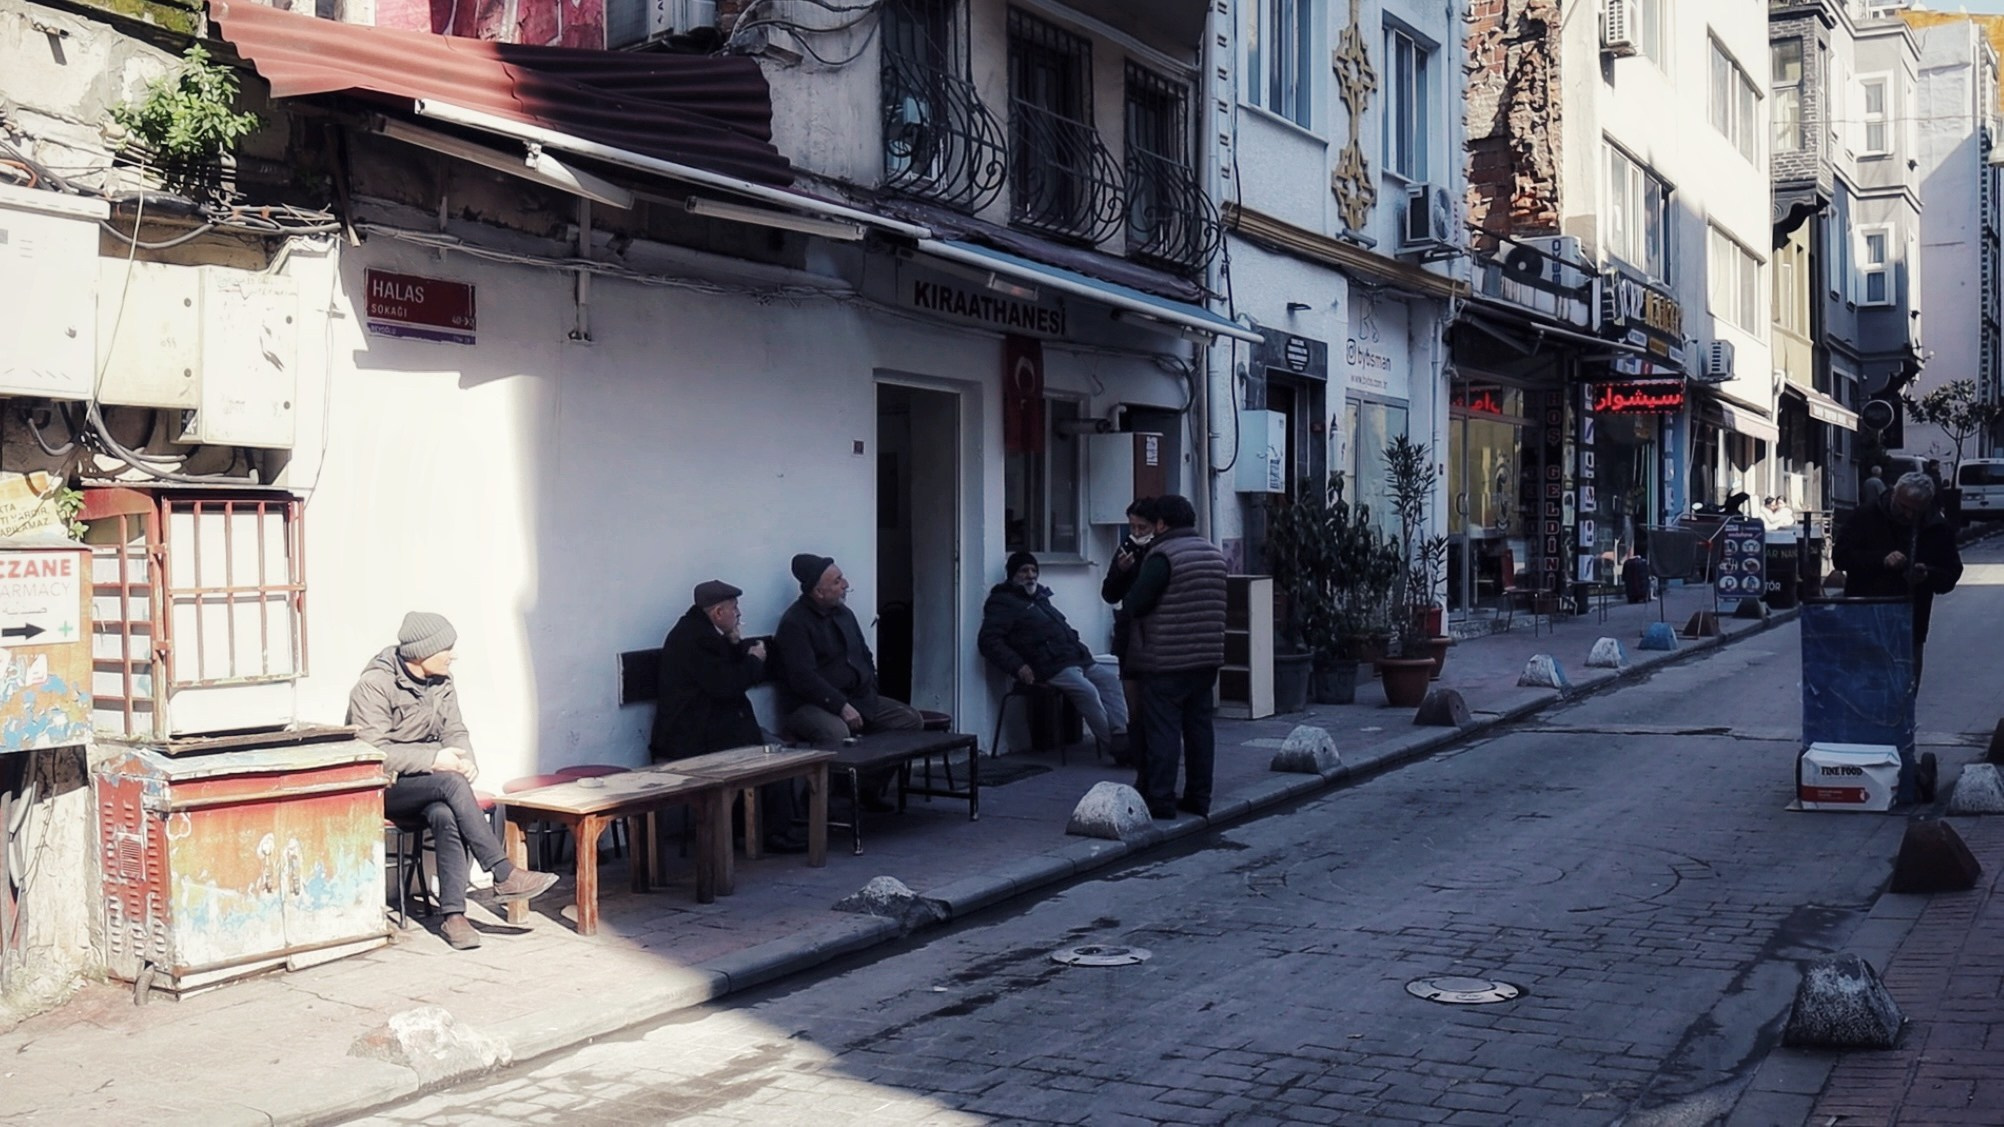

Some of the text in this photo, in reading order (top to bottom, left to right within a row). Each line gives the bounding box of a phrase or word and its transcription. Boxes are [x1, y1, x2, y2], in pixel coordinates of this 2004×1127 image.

[373, 279, 424, 304] HALAS
[371, 303, 407, 318] SOKAĞI
[914, 280, 1066, 336] KIRAATHANESİ
[1546, 391, 1562, 447] HOŞ
[1821, 765, 1863, 776] FINE FOOD
